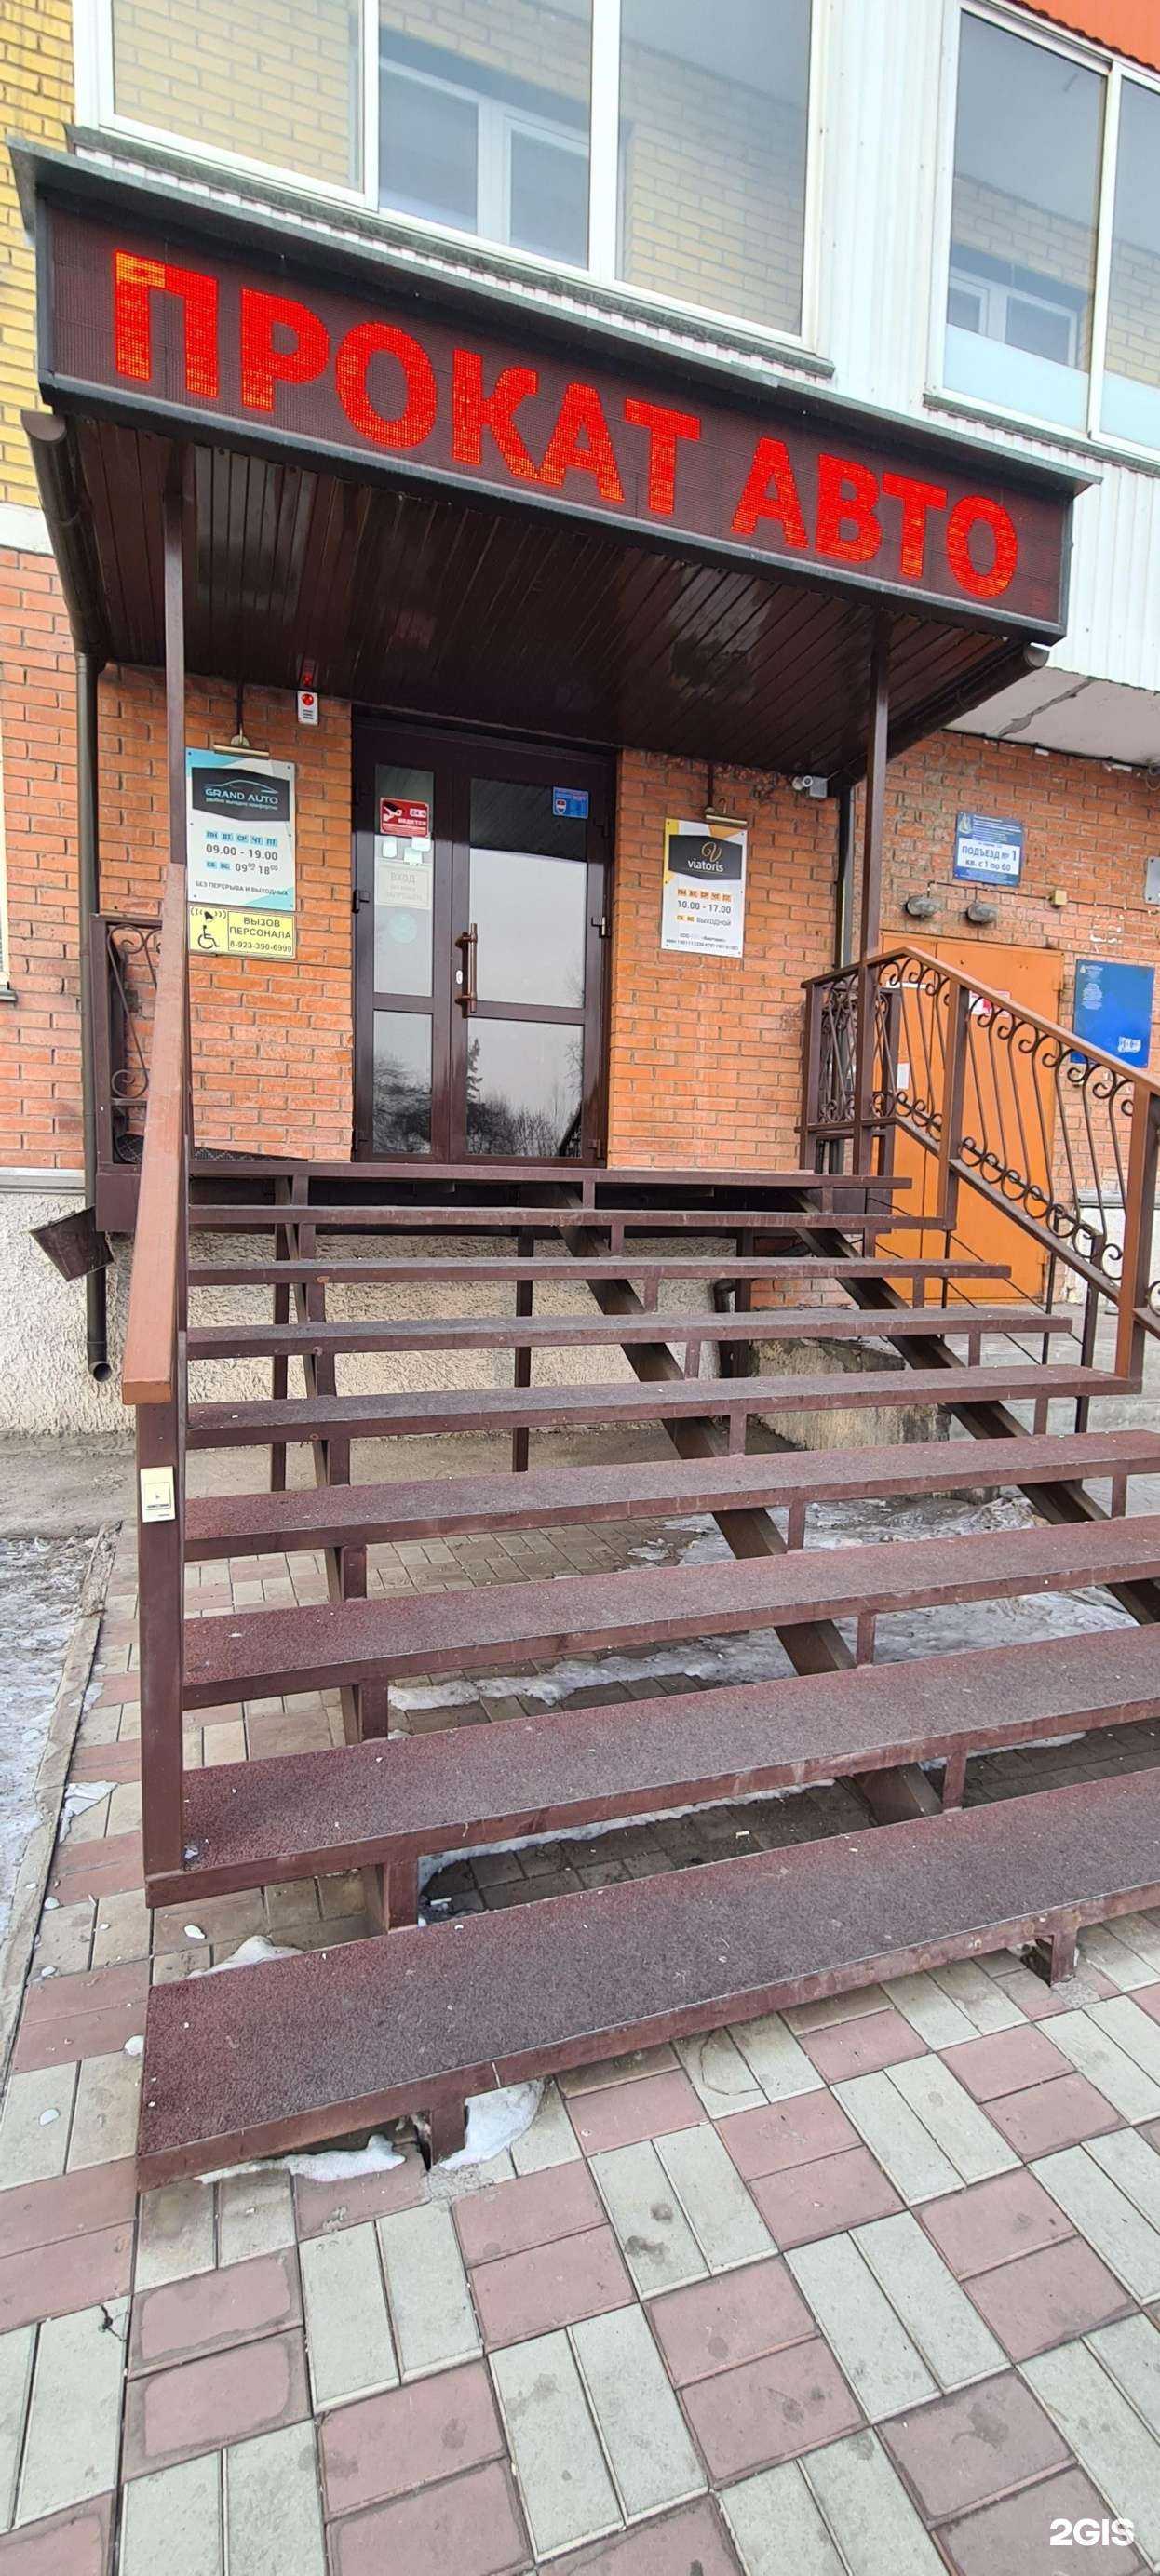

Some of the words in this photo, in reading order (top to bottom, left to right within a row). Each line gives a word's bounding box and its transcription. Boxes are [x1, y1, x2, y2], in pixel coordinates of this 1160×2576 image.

[114, 248, 701, 517] ПРОКАТ
[731, 436, 1018, 599] АВТО
[205, 788, 245, 800] GRAND
[247, 794, 278, 804] AUTO
[206, 843, 236, 855] 09.00
[249, 849, 278, 861] 19.00
[962, 845, 1000, 860] ПОДЪЕЗД
[1012, 851, 1017, 861] 1
[687, 858, 723, 873] viatoris
[965, 859, 977, 867] кв.
[1001, 864, 1011, 872] 60
[209, 882, 244, 892] ПЕРЕРЫВА
[250, 887, 288, 896] ВЫХОДНЫХ
[678, 900, 700, 910] 10.00
[708, 904, 731, 914] 17.00
[243, 917, 280, 928] ВЫЗОВ
[696, 917, 731, 926] ВЫХОДНОЙ
[229, 926, 291, 939] ПЕРСОНАЛА
